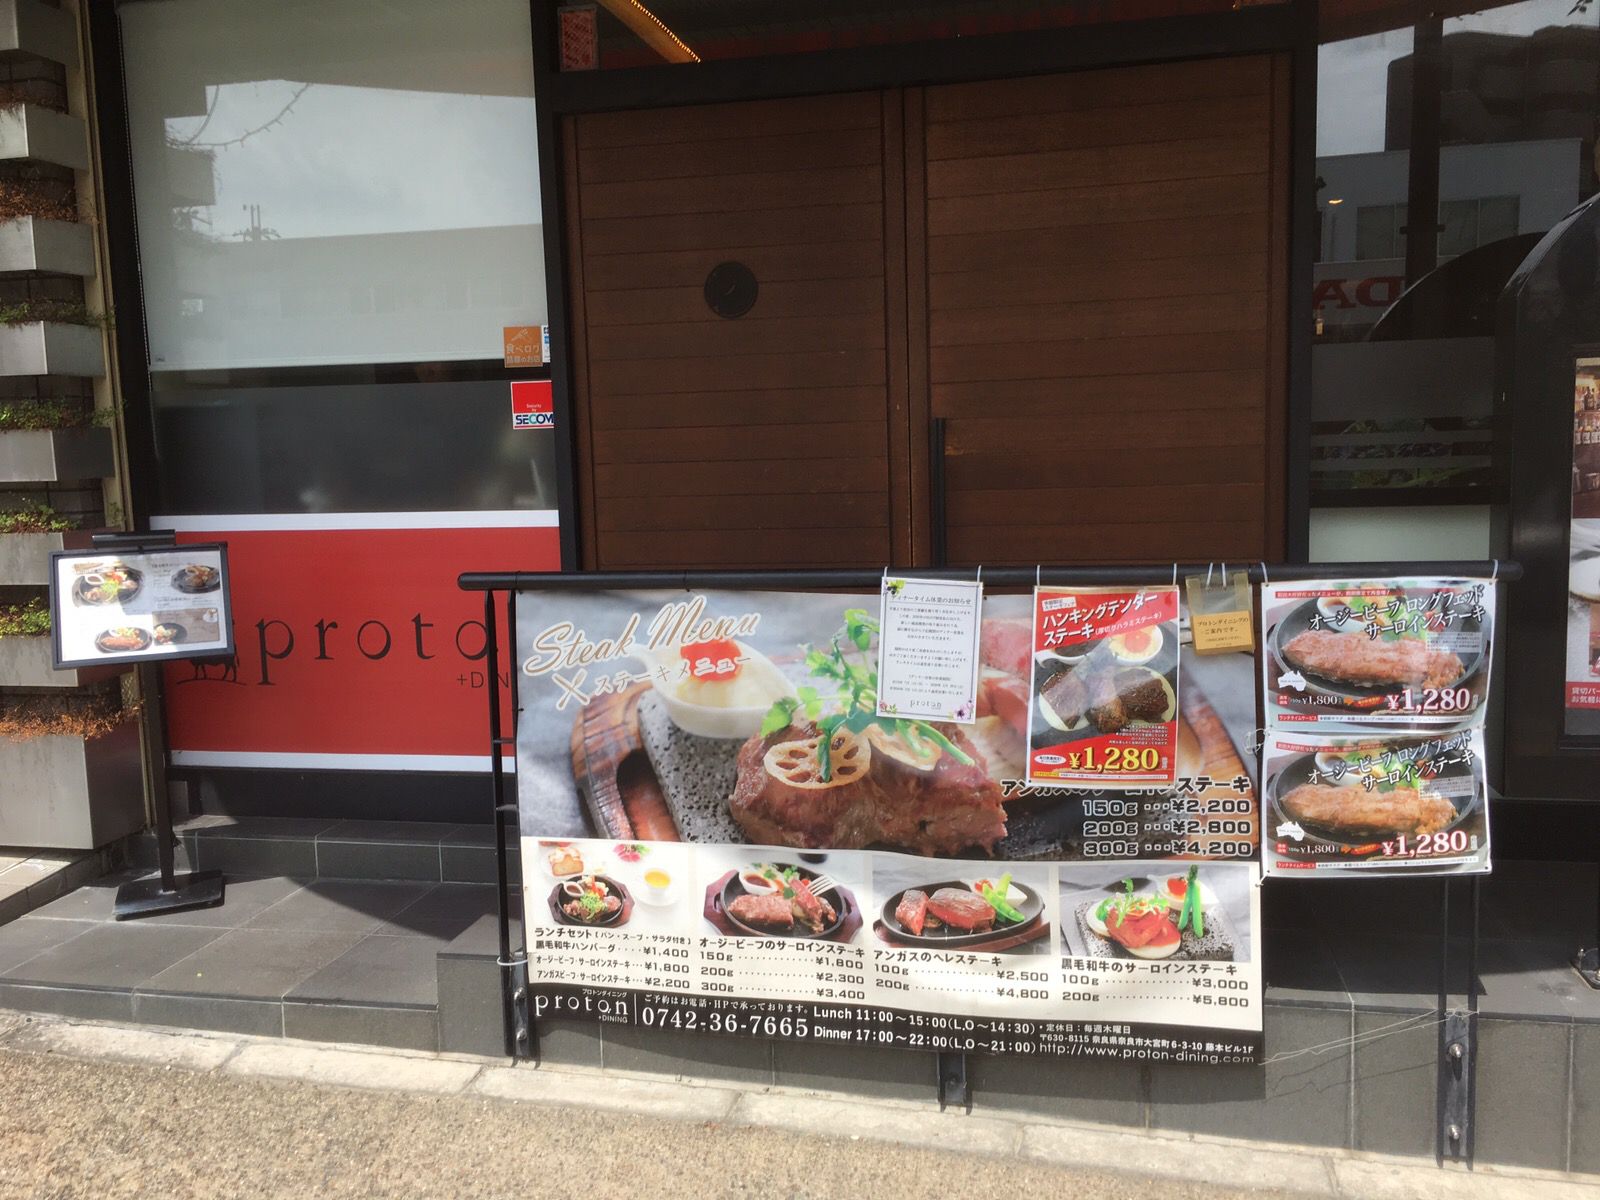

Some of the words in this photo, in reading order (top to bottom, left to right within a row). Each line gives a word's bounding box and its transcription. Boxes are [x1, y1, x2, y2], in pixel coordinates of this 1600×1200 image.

[1042, 590, 1158, 630] ハンキングテンダー
[1308, 601, 1403, 631] オージービーフ
[1406, 584, 1485, 612] ロングフェッド
[1364, 604, 1487, 641] サーロインステーキ
[523, 613, 640, 676] Steak
[648, 595, 761, 652] Menu
[1043, 623, 1095, 647] ステーキ
[595, 655, 754, 695] ステーキメニュー
[1387, 687, 1472, 712] ¥1,280
[1069, 747, 1159, 773] ¥1,280
[1306, 752, 1393, 786] オージービーフ
[1396, 730, 1473, 762] ロングフェッド
[1362, 749, 1476, 793] サーロインステーキ
[1082, 800, 1138, 816] 150g
[1082, 821, 1138, 836] 200g
[1083, 841, 1139, 856] 300g
[1381, 830, 1469, 857] ¥1,280
[534, 927, 592, 939] ランチセット
[535, 940, 616, 953] 黒毛和牛ハンバーグ
[643, 946, 689, 958] ¥1,400
[698, 936, 866, 958] オージービーフのサーロインステーキ
[644, 961, 690, 974] ¥1,800
[700, 950, 734, 963] 150g
[815, 957, 865, 970] ¥1,800
[873, 949, 1002, 967] アンガスのヘレステーキ
[1061, 957, 1238, 976] 黒毛和牛のサーロインステーキ
[644, 976, 691, 990] ¥2,200
[700, 965, 735, 978] 200g
[816, 972, 865, 986] ¥2,300
[875, 964, 910, 976] 100g
[996, 969, 1050, 983] ¥2,500
[1061, 974, 1100, 987] 100g
[1191, 976, 1249, 991] ¥3,000
[582, 988, 628, 999] プロトンダイニング
[701, 981, 735, 993] 300g
[816, 987, 866, 1001] ¥3,400
[875, 978, 911, 991] 200g
[996, 986, 1050, 1000] ¥4,800
[534, 994, 628, 1018] proton
[643, 994, 809, 1015] ご予約はお電話・HPで承っております。
[1062, 991, 1100, 1002] 200g
[1192, 994, 1250, 1009] ¥5,800
[642, 1006, 809, 1038] 0742-36-7665
[813, 1005, 852, 1021] Lunch
[813, 1025, 852, 1041] Dinner
[1039, 1033, 1090, 1044] 〒630-8115
[1039, 1042, 1255, 1065] http://www.proton-dining.com
